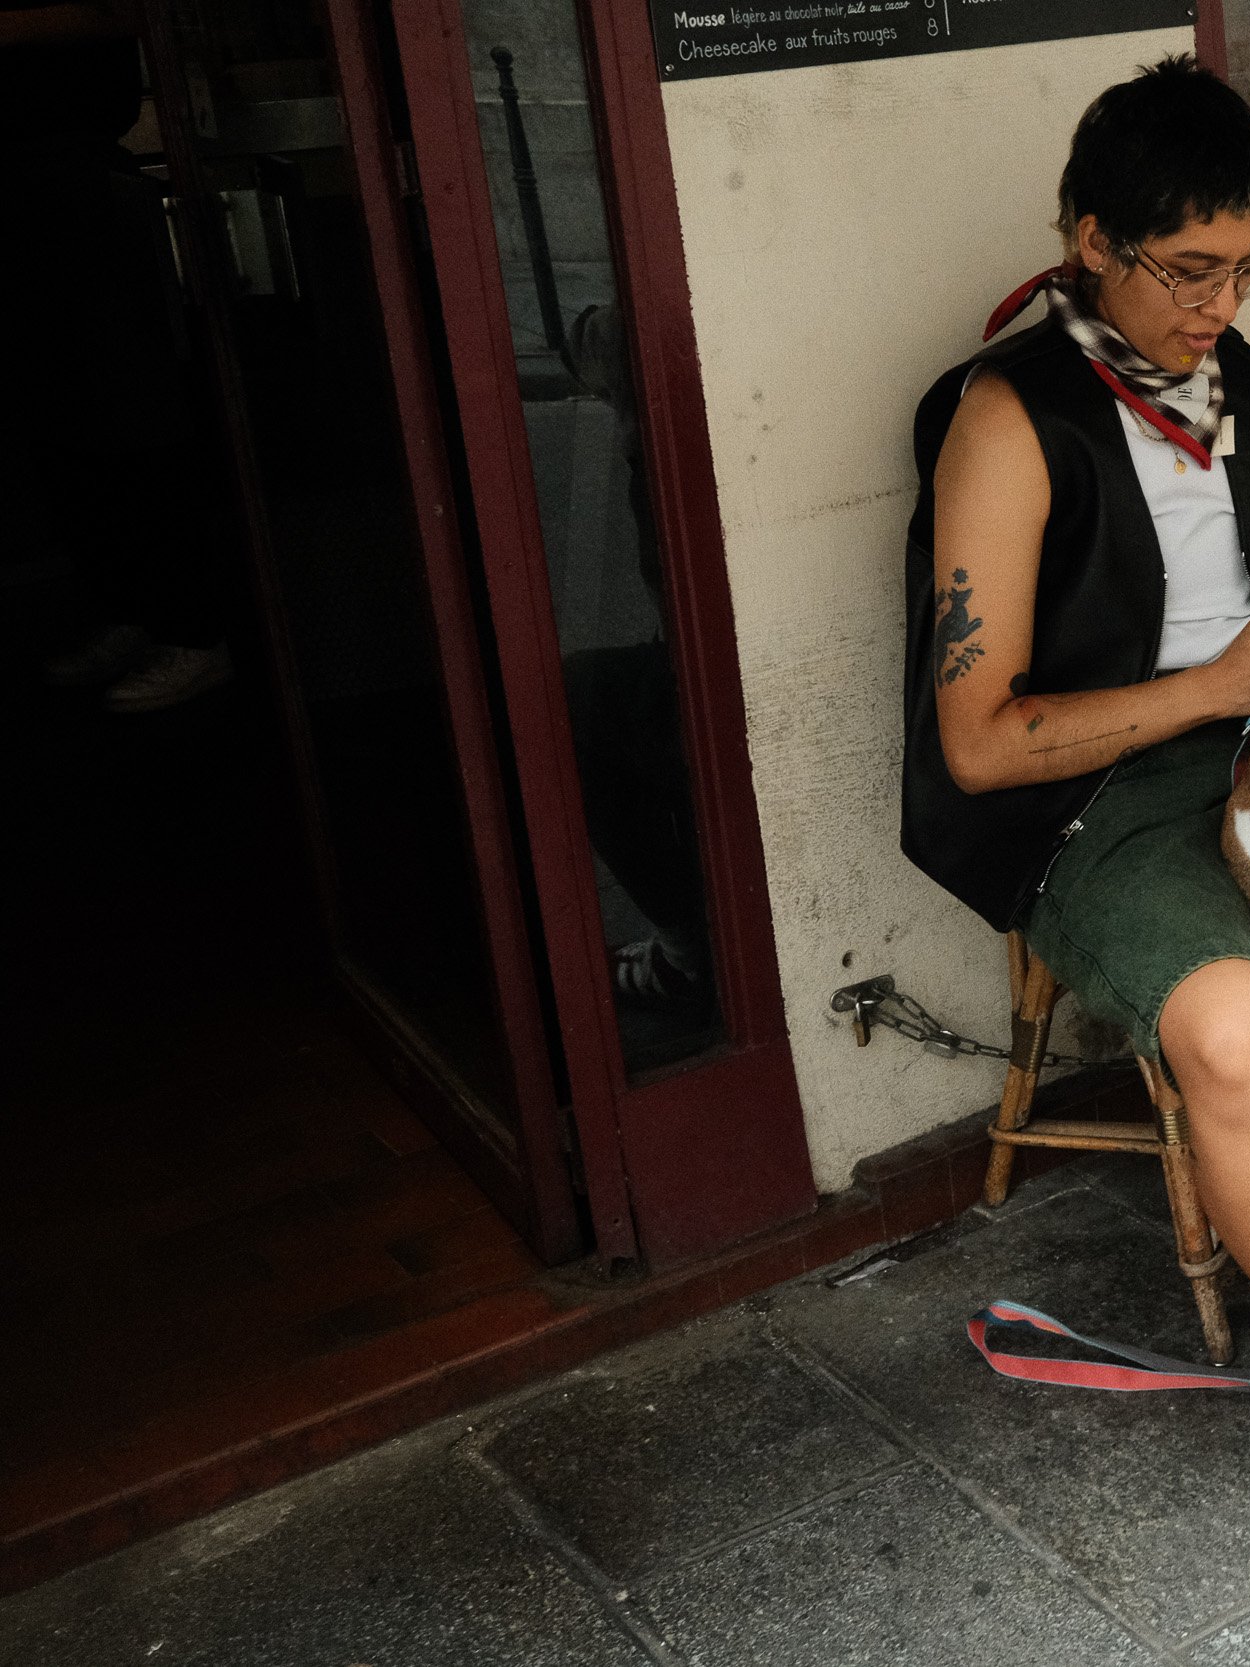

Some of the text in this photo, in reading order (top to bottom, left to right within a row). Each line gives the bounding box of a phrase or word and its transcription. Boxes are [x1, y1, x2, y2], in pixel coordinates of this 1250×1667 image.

[674, 11, 726, 29] Mousse
[730, 7, 767, 29] légère
[769, 11, 781, 22] au
[784, 4, 822, 20] chocolat
[869, 4, 882, 13] au
[678, 17, 939, 61] Cheesecake aux fruits rouges 8
